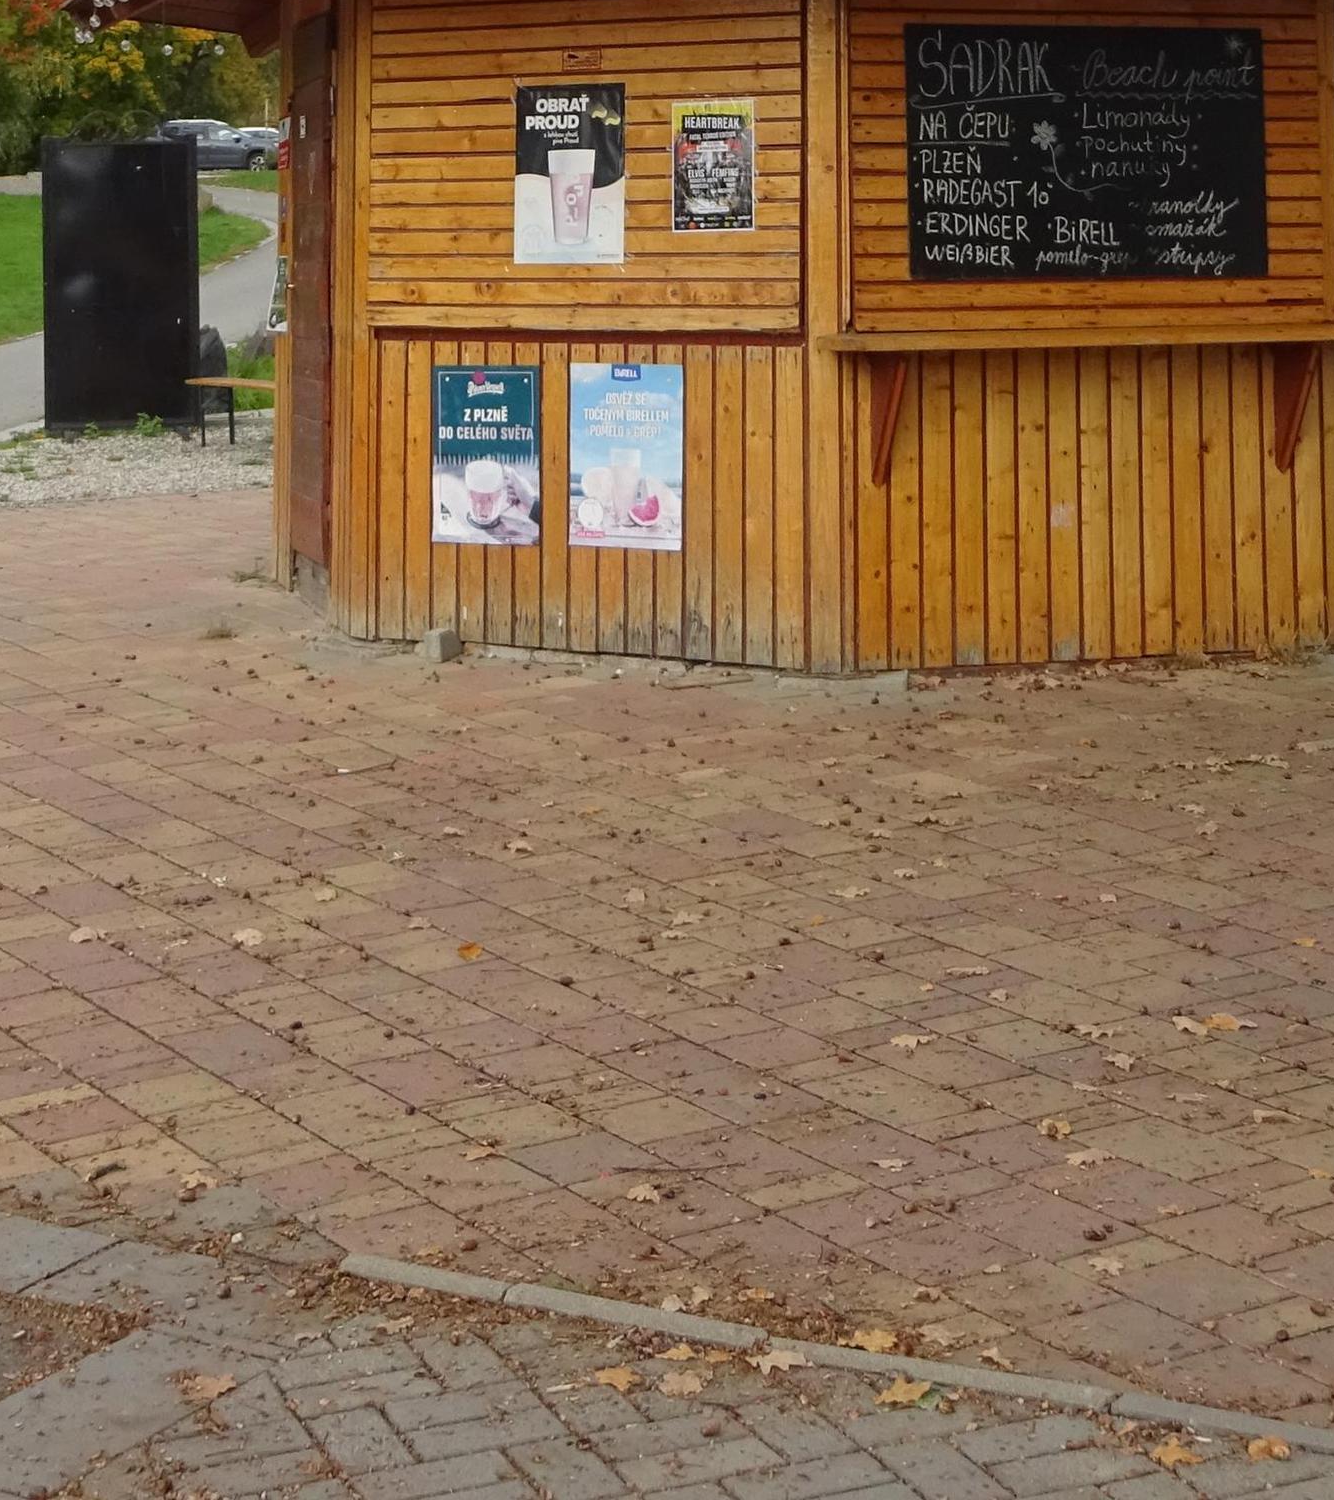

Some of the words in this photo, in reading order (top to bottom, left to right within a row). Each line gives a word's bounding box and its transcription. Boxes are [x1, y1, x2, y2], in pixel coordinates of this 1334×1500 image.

[919, 30, 1055, 98] SADRAK
[1082, 48, 1179, 90] Beach
[1183, 51, 1257, 104] point
[535, 93, 590, 113] OBRAŤ
[525, 114, 580, 130] PROUD
[684, 115, 741, 129] HEARTBREAK
[919, 111, 948, 140] NA
[1081, 102, 1191, 139] Limonády
[920, 146, 982, 175] PLZEŇ
[922, 178, 1023, 209] RADEGAST
[926, 211, 1031, 243] ERDINGER
[463, 408, 472, 422] Z
[473, 405, 508, 423] PLZNĚ
[438, 426, 454, 440] DO
[456, 424, 498, 440] CELÉHO
[500, 424, 534, 441] SVĚTA
